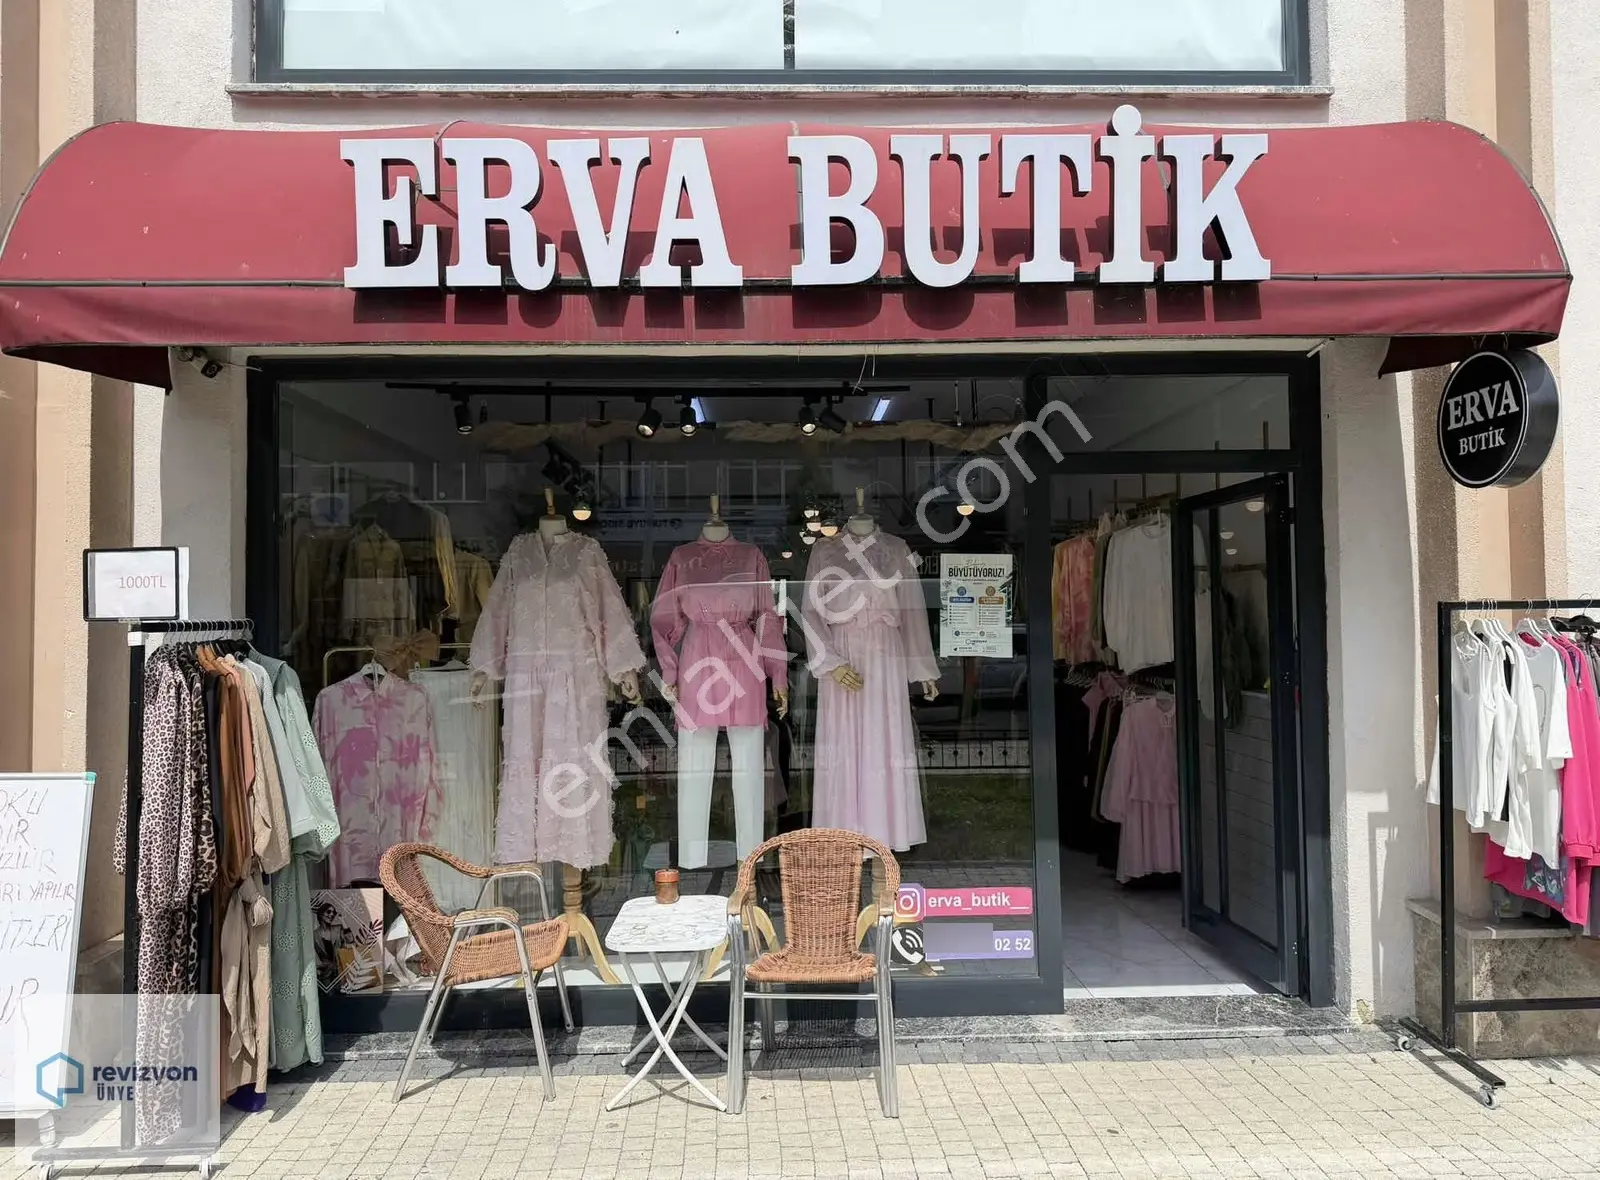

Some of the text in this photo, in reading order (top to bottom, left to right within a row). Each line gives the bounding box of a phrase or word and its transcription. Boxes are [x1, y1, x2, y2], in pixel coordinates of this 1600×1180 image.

[340, 104, 1272, 291] ERVA BUTİK
[1447, 379, 1520, 431] ERVA
[1458, 426, 1507, 456] BUTİK
[118, 574, 167, 589] 1000TL
[994, 937, 1032, 951] 02 52
